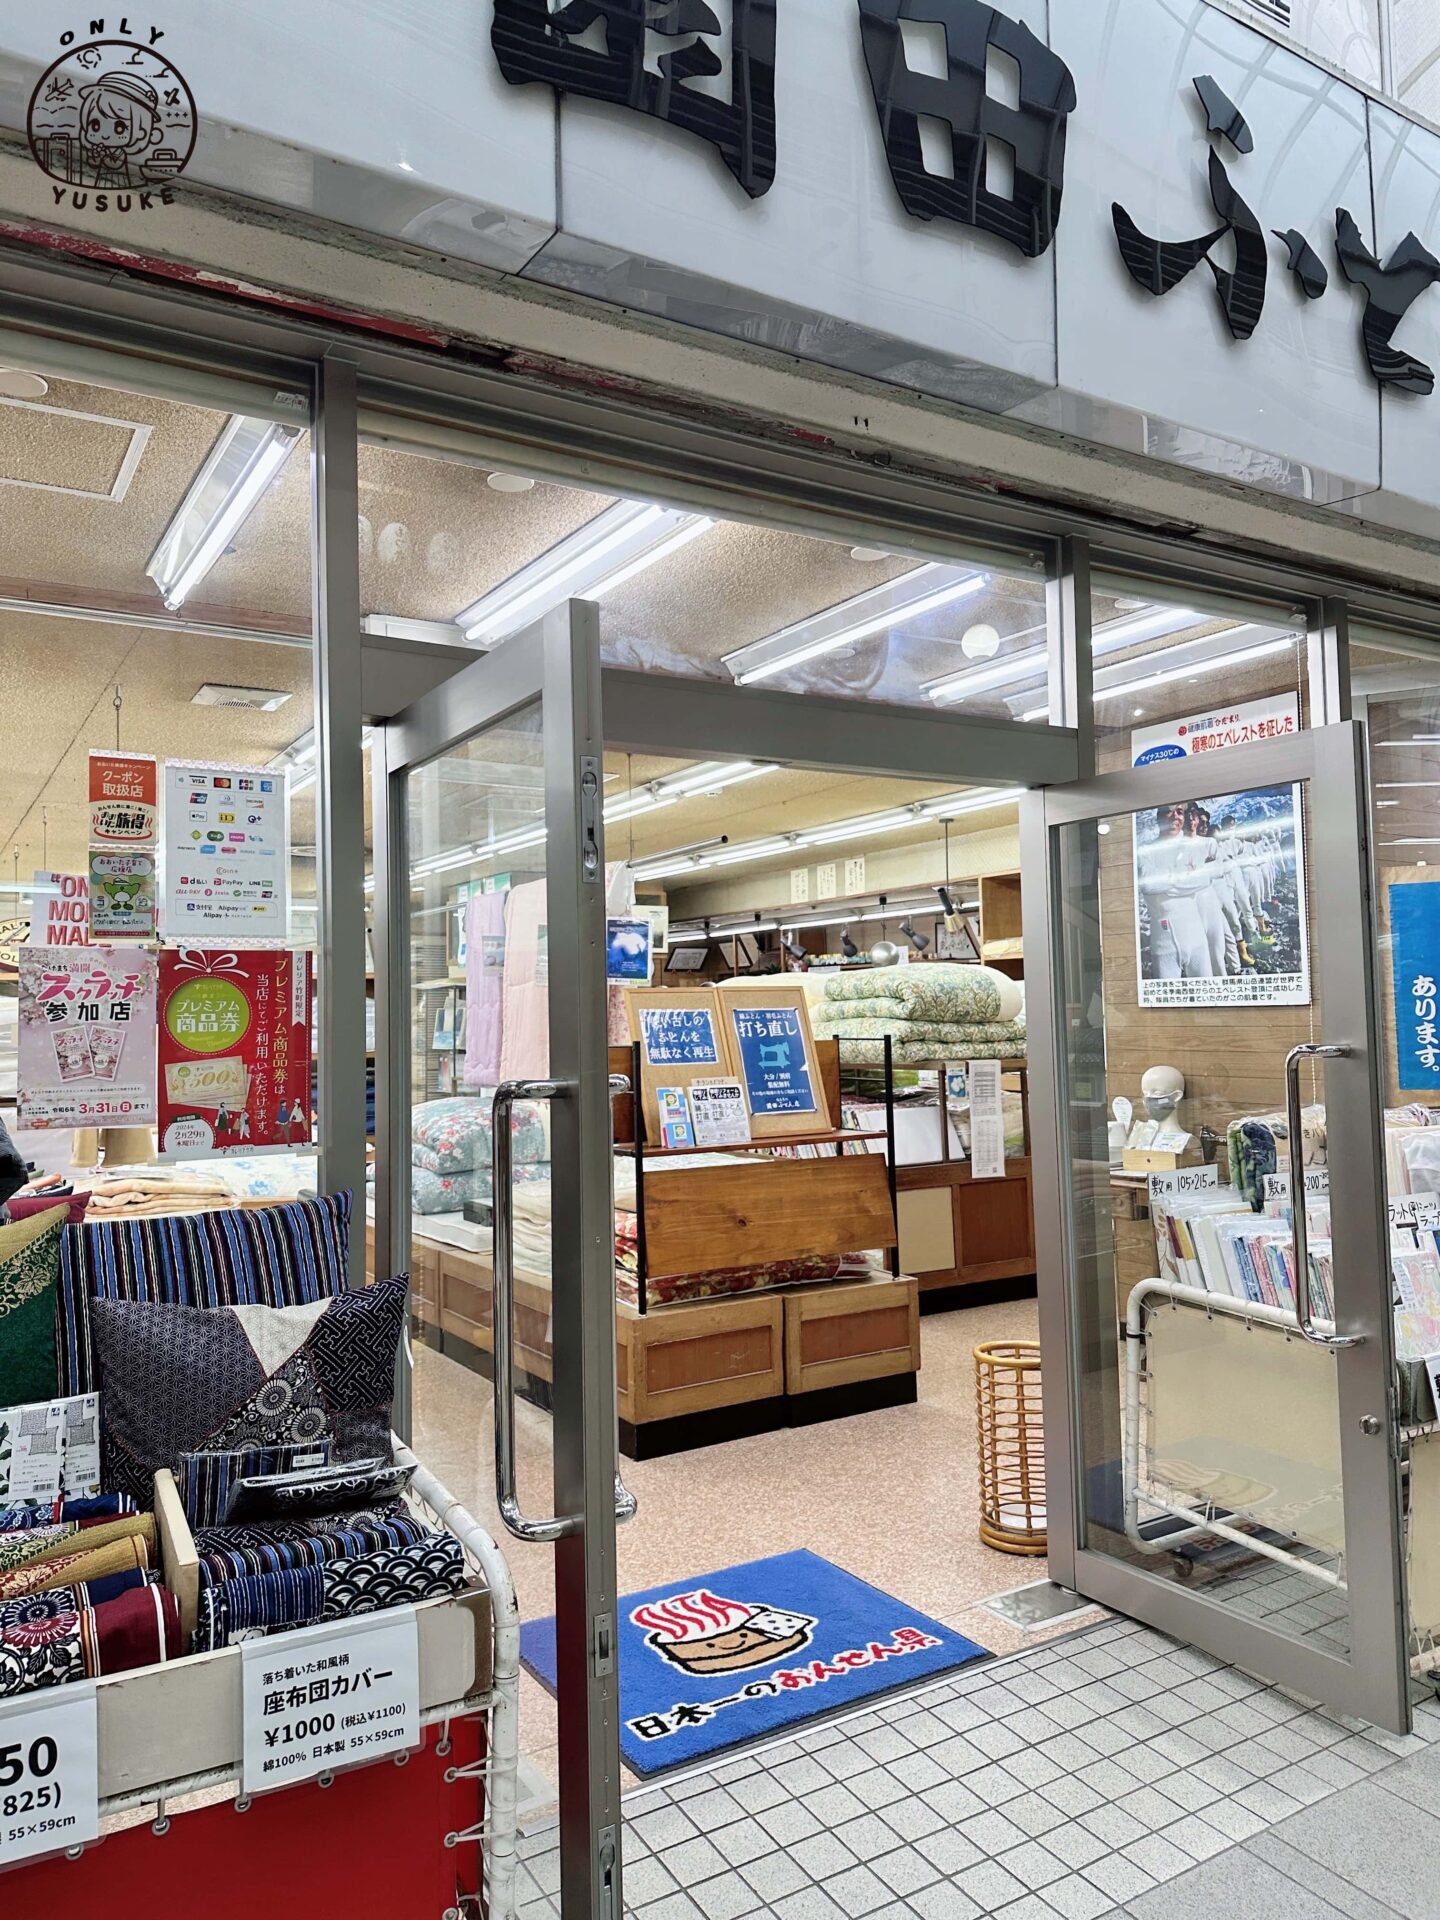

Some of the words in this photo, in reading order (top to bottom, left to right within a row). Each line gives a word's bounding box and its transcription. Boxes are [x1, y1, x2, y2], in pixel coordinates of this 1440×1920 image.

[102, 783, 144, 797] 取扱店
[103, 771, 144, 783] クーポン
[36, 970, 141, 1001] スクラッチ
[46, 1002, 131, 1022] 参加店
[176, 1000, 240, 1012] プレミアム
[175, 1013, 241, 1034] 商品券
[273, 957, 289, 1095] プレミアム商品券は
[739, 1020, 798, 1038] 打ち直し
[1411, 974, 1440, 1073] あります。
[255, 973, 269, 1136] 当店にてご利用いただけます。
[78, 1102, 118, 1114] 3月31日
[174, 1131, 206, 1140] 2月29日
[262, 1653, 350, 1686] 落ち着いた和風柄
[631, 1627, 944, 1739] 日本一のおんせん県
[263, 1667, 393, 1716] 座布団カバー
[264, 1713, 335, 1748] ¥1000
[341, 1702, 406, 1730] (税込¥1100)
[262, 1751, 307, 1773] 綿100%
[312, 1739, 346, 1759] 日本製
[350, 1727, 405, 1748] 55×59cm
[9, 1815, 76, 1841] 55×59cm
